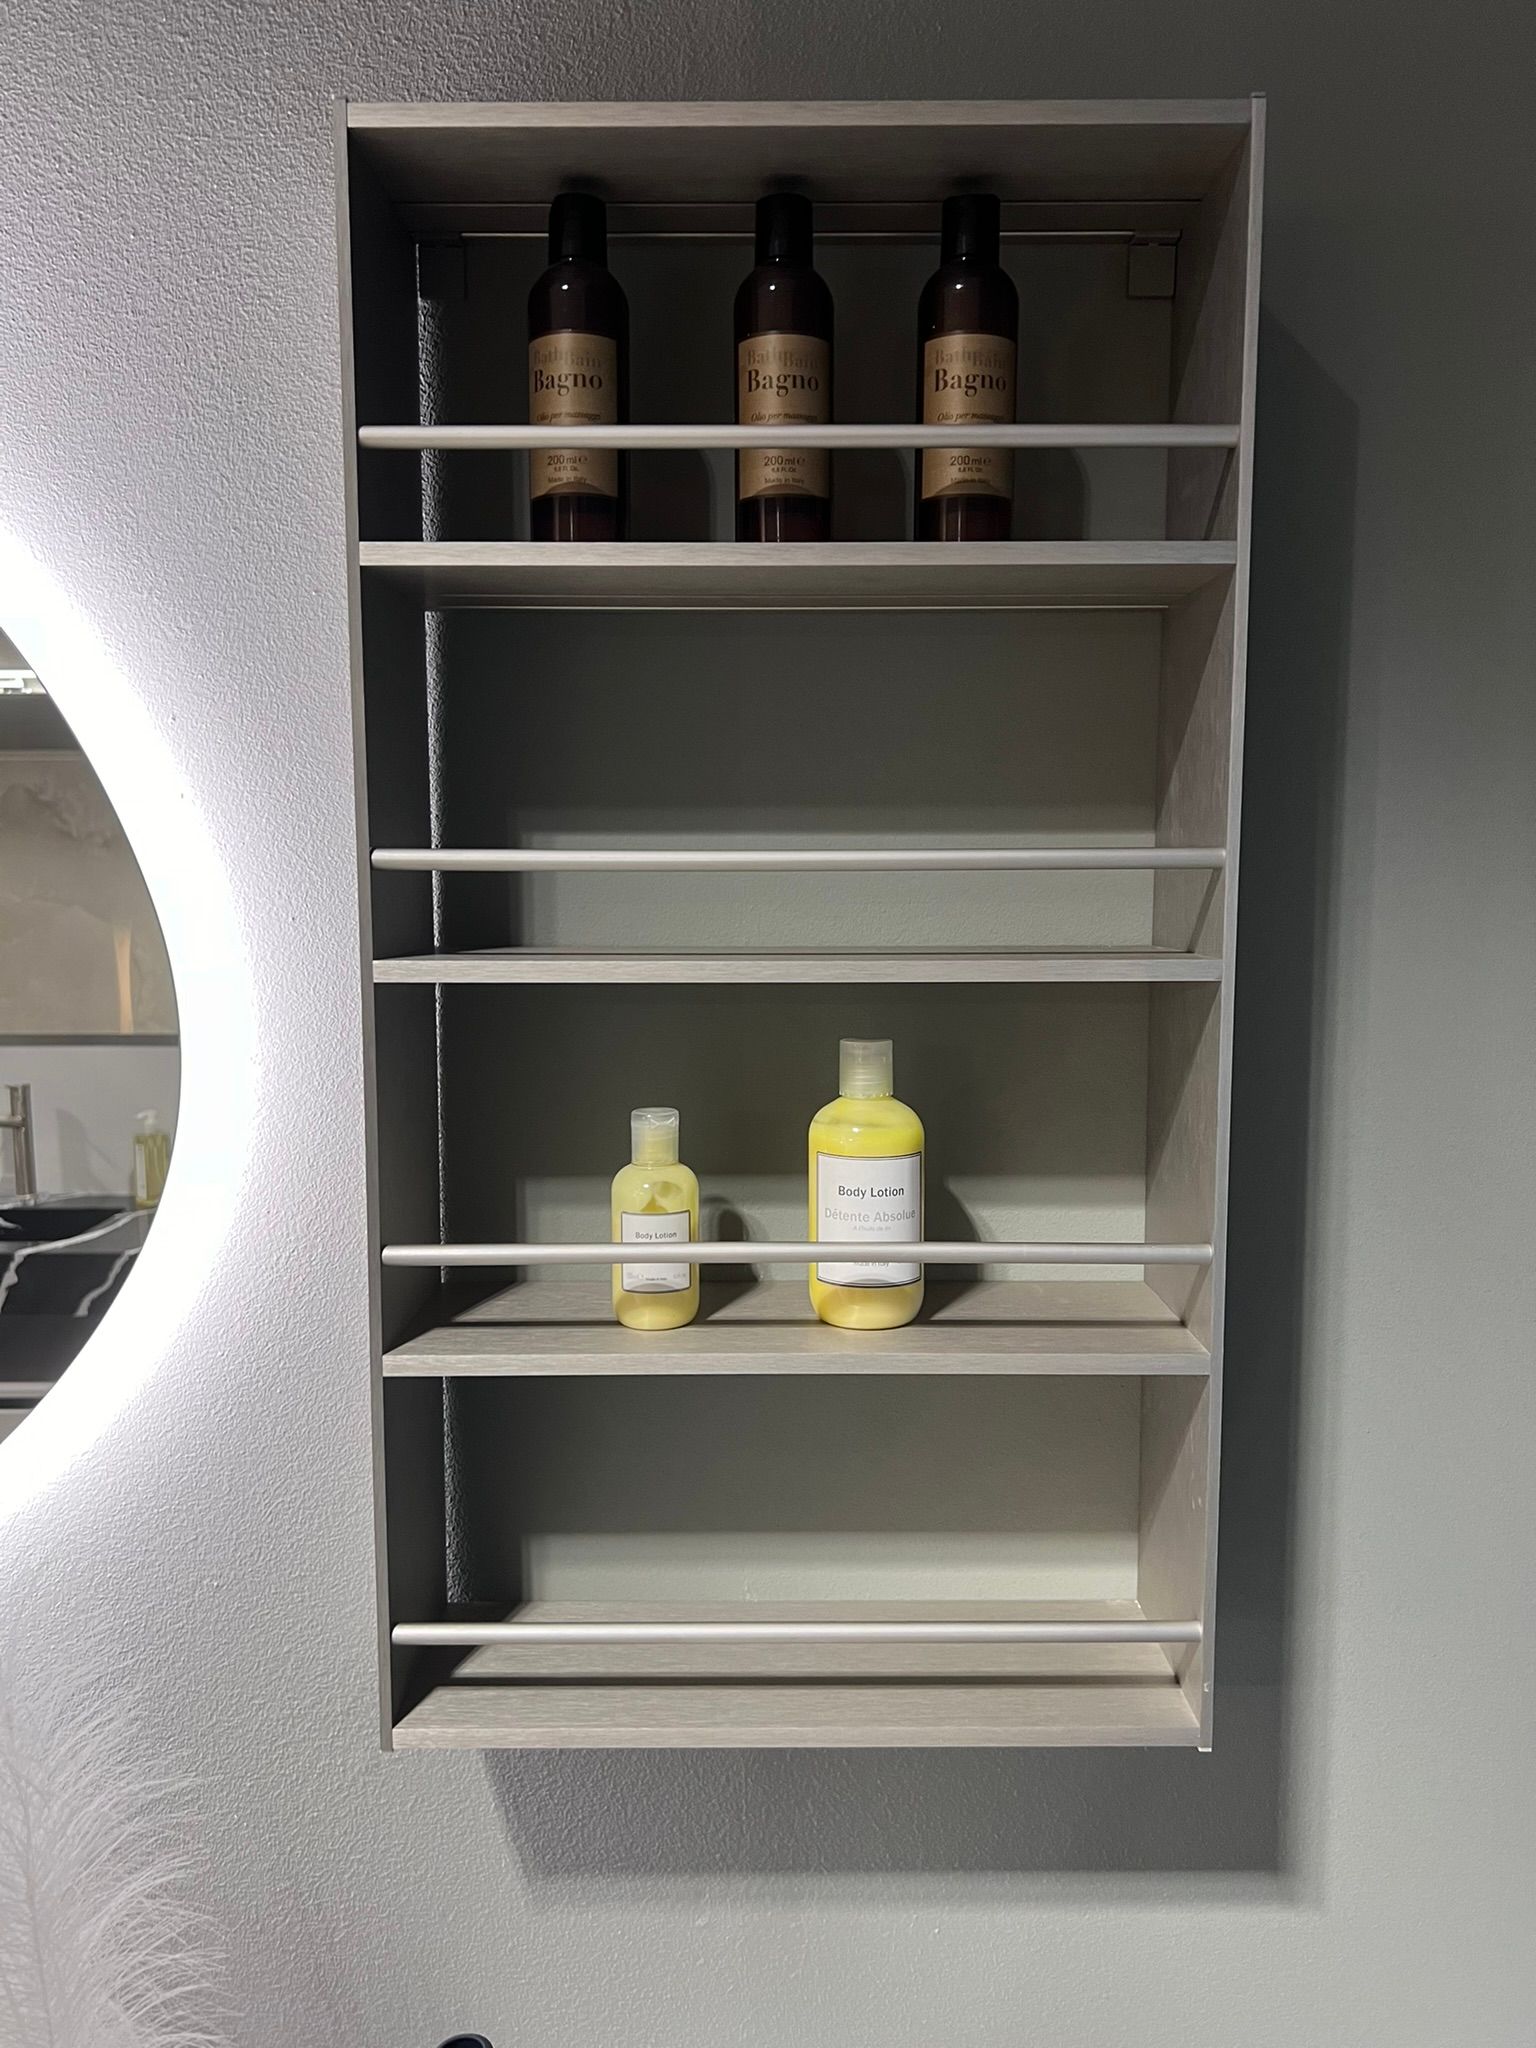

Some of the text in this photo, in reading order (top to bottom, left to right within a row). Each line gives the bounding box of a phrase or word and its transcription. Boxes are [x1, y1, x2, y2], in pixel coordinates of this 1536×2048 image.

[533, 368, 603, 397] Bagno
[747, 368, 820, 398] Bagno
[934, 368, 1007, 398] Bagno
[546, 454, 565, 466] 200
[566, 455, 577, 465] ml
[763, 455, 784, 467] 200
[784, 456, 796, 466] ml
[949, 455, 970, 467] 200
[971, 456, 982, 466] ml
[838, 1185, 905, 1200] Body Lotion
[824, 1207, 917, 1223] Détente Absolue
[635, 1231, 678, 1241] Body Lotion
